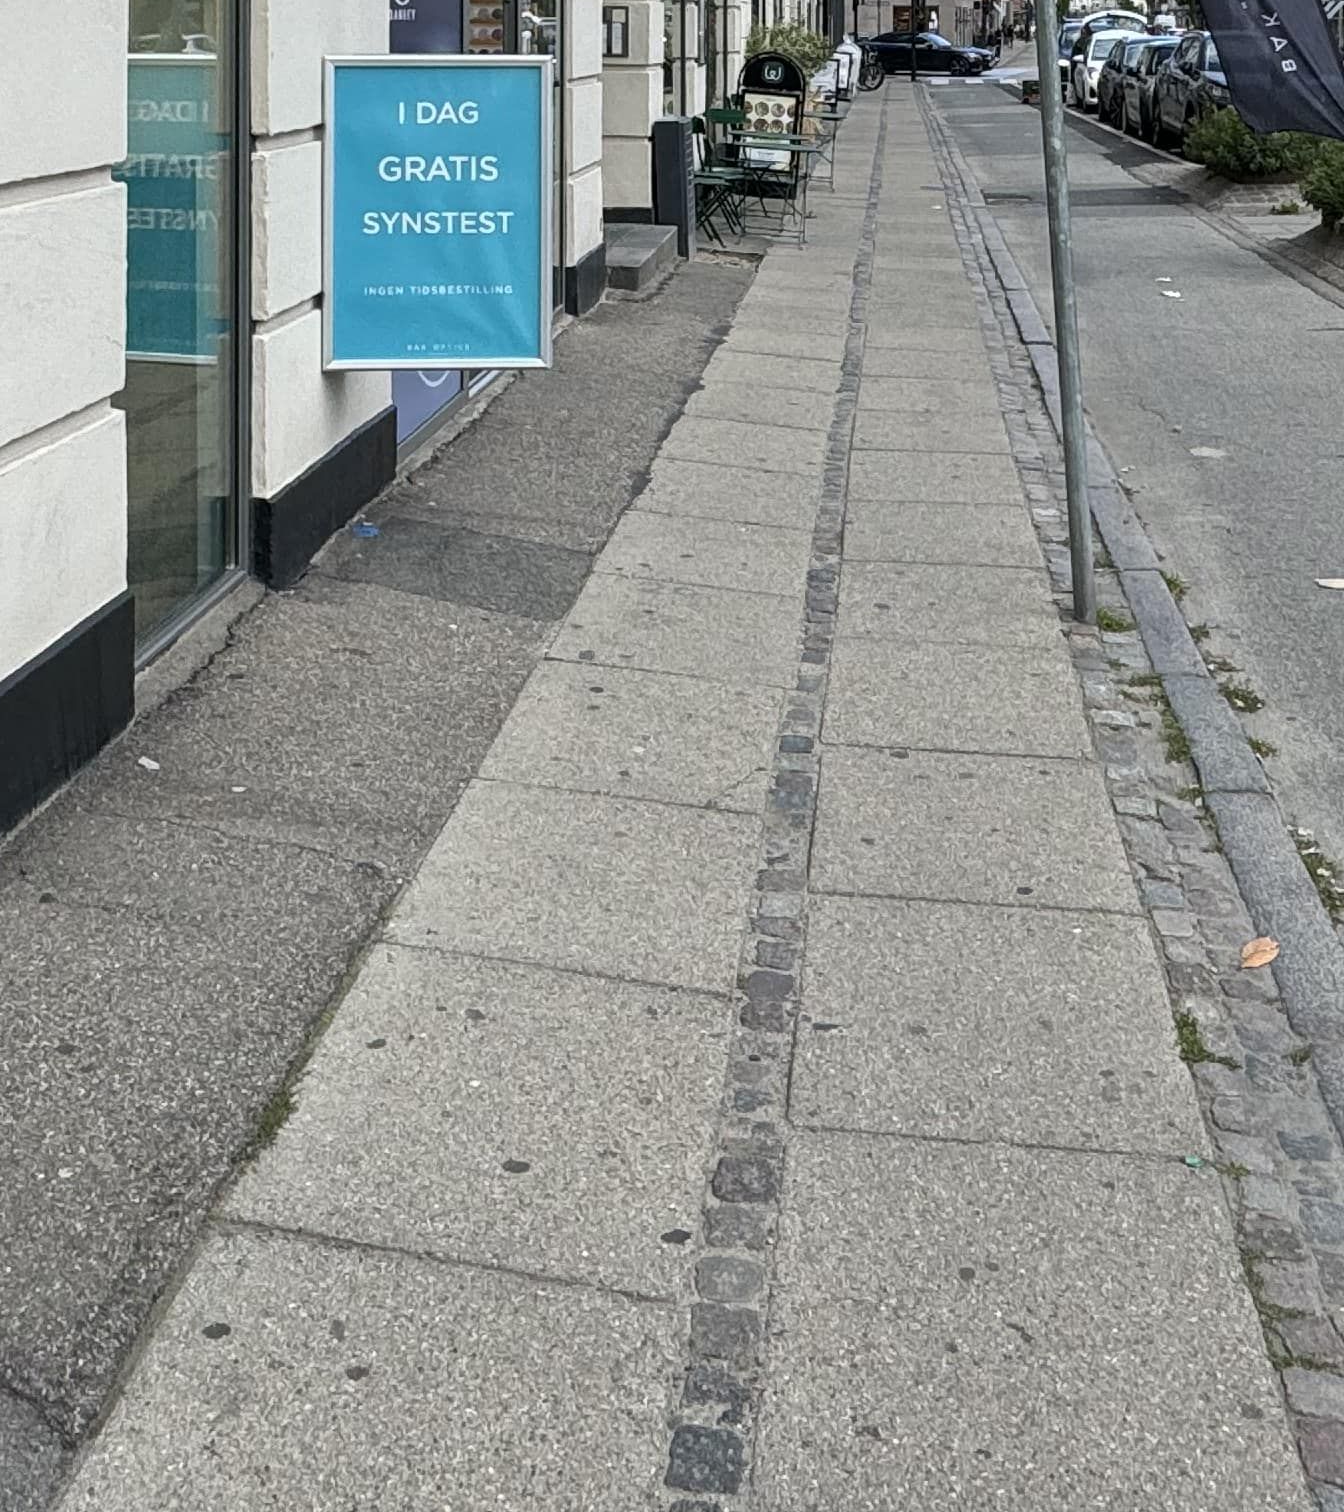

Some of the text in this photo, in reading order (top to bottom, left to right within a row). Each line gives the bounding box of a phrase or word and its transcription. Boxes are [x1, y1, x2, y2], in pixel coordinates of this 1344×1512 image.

[398, 100, 479, 125] I DAG
[378, 155, 499, 182] GRATIS
[362, 210, 515, 235] SYNSTEST
[363, 284, 513, 297] INGEN TIDSBESTILLING
